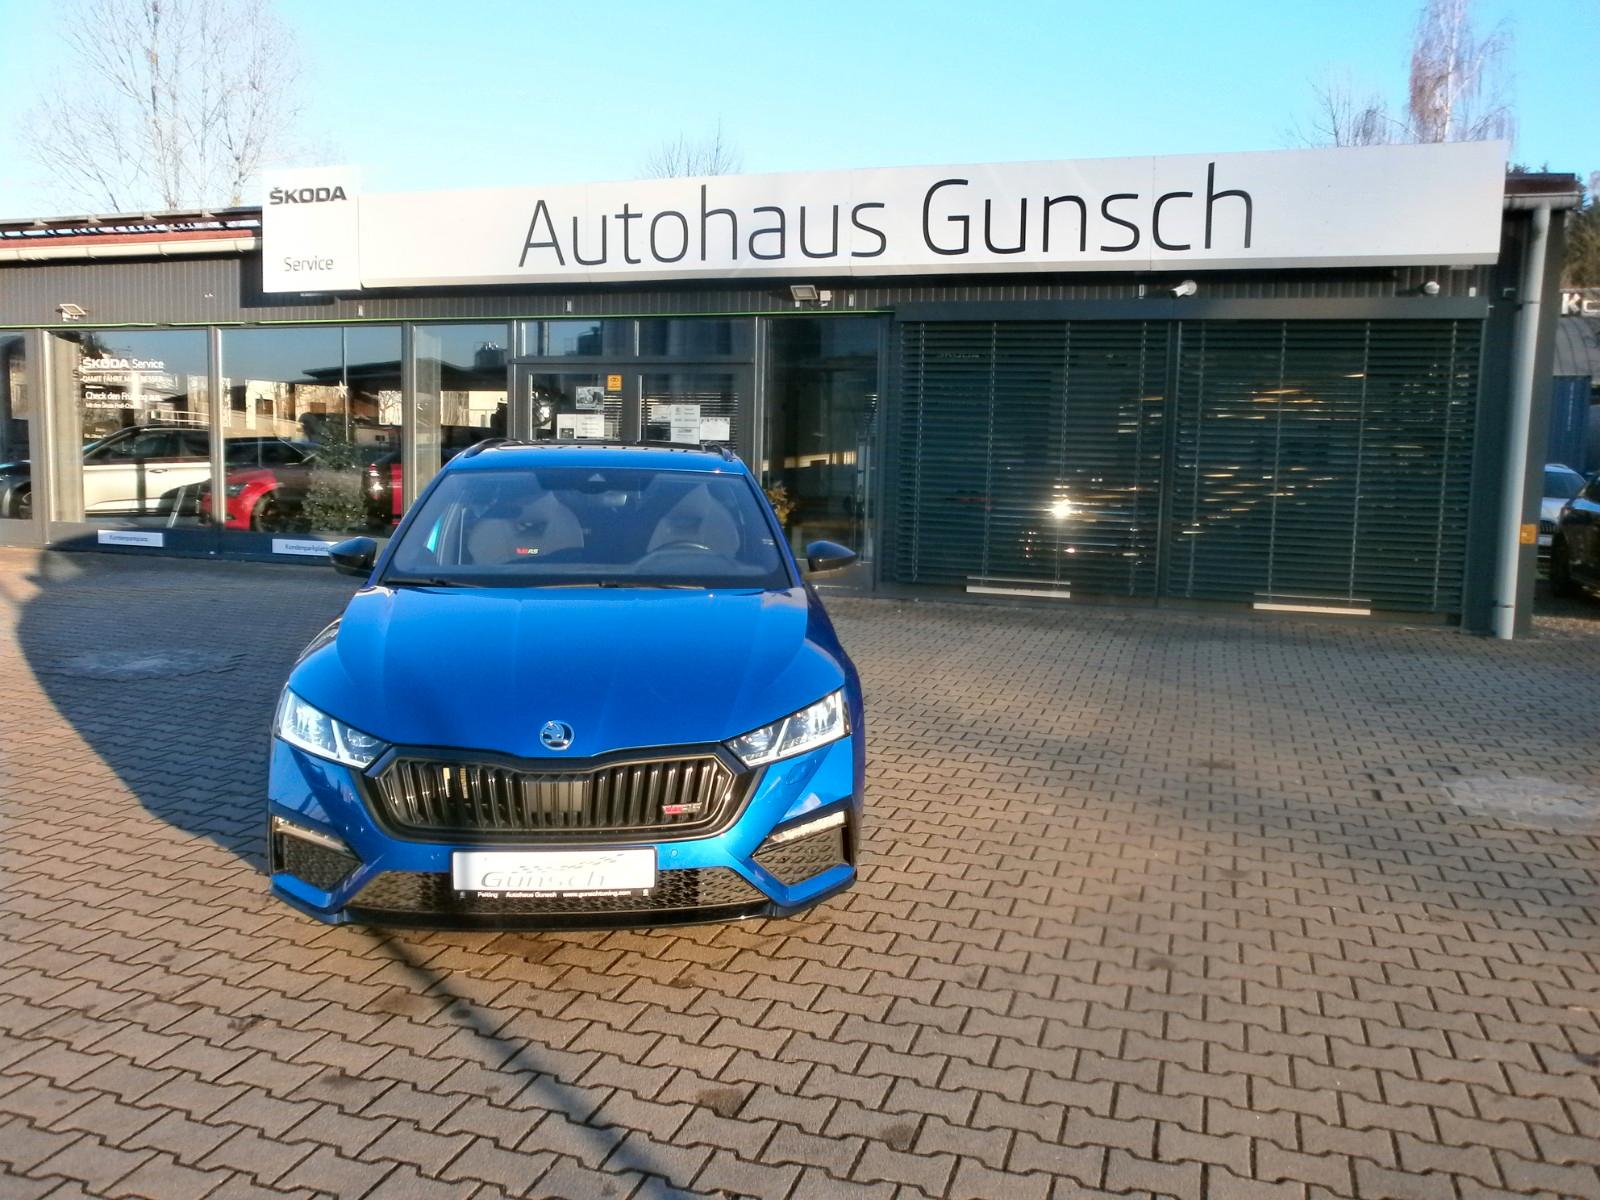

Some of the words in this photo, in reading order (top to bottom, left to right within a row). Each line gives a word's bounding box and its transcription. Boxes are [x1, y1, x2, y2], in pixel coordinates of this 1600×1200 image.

[269, 186, 347, 205] ŠKODA
[519, 185, 886, 267] Autohaus
[923, 162, 1253, 255] Gunsch
[284, 256, 334, 272] Service
[132, 359, 164, 368] Service
